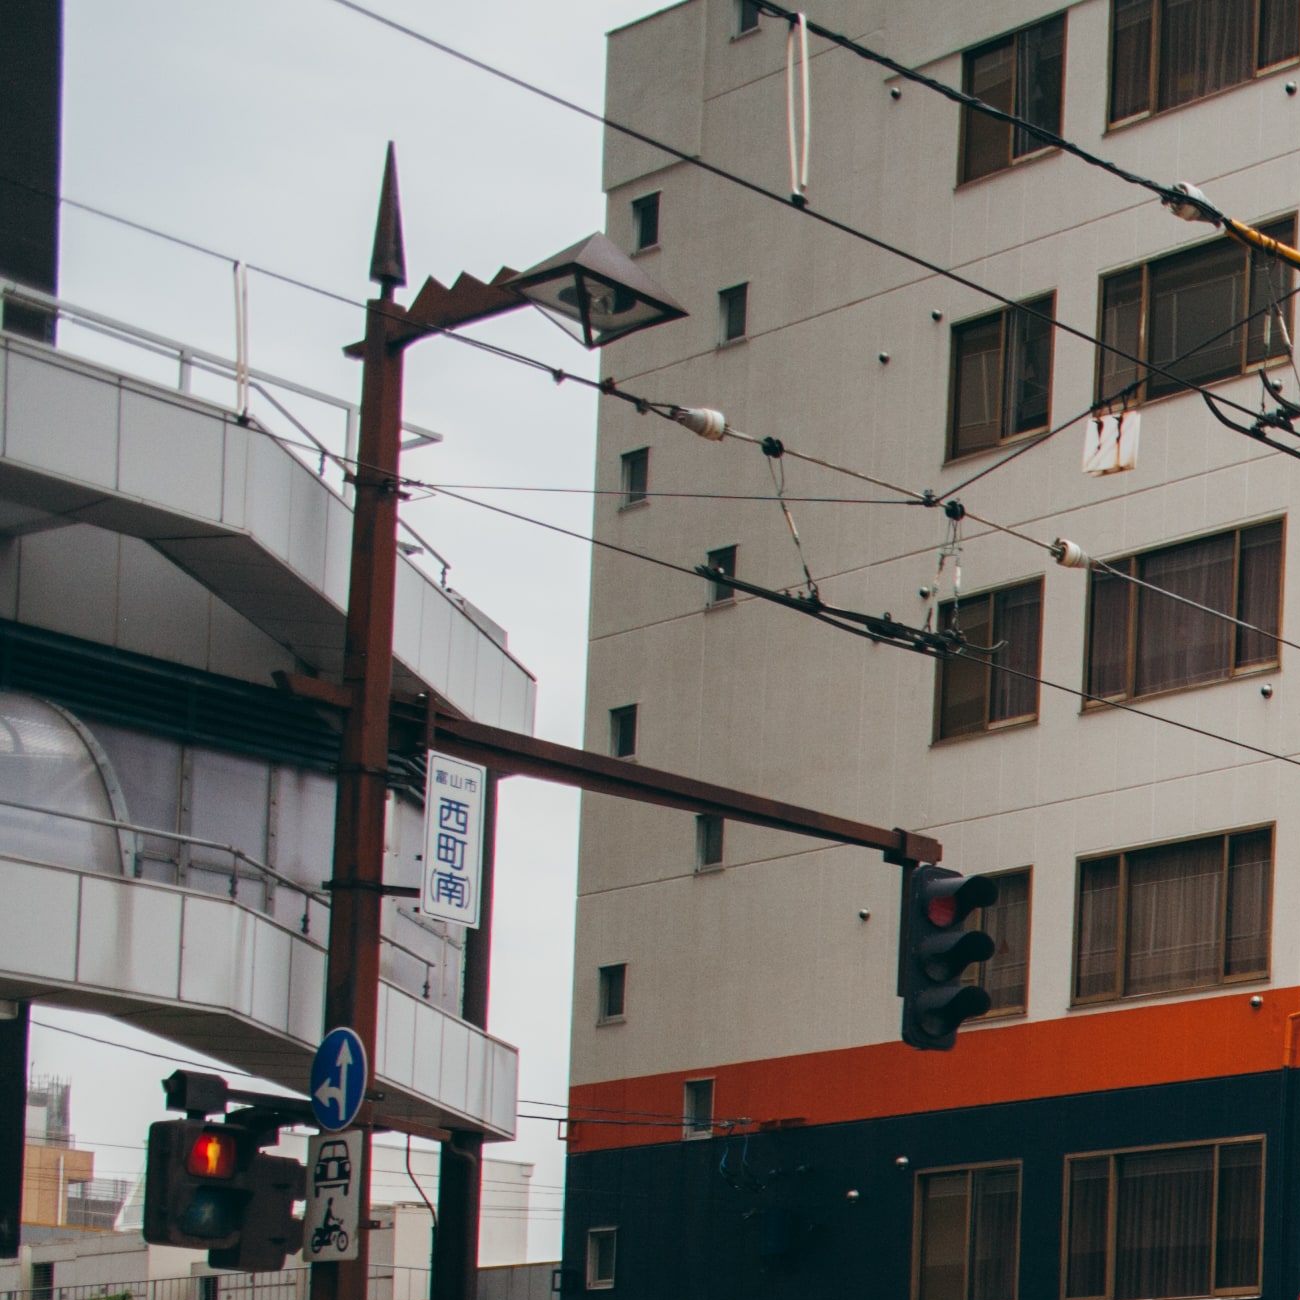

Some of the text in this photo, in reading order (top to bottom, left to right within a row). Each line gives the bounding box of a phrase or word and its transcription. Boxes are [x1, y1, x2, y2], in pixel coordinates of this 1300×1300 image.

[435, 769, 478, 793] 富山市
[430, 796, 472, 910] 西町(南)
